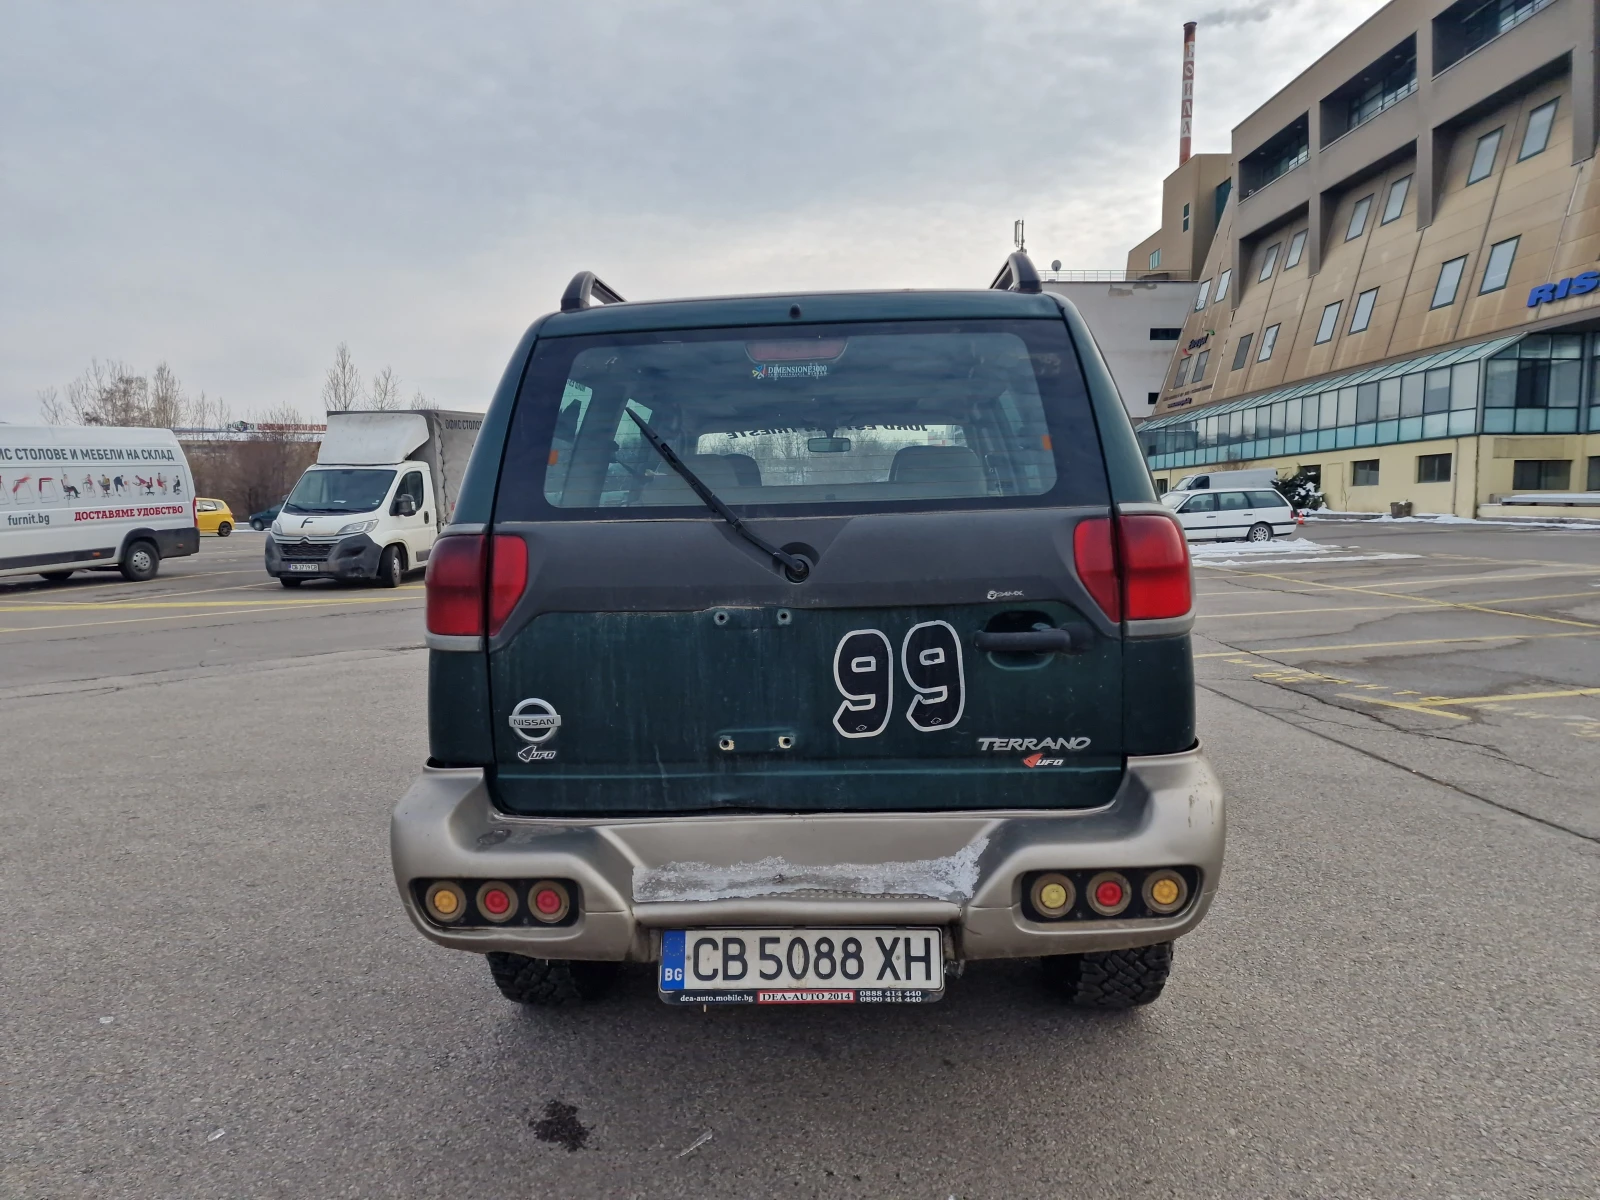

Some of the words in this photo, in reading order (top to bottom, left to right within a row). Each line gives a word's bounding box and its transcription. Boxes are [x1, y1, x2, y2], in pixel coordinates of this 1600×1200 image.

[15, 448, 68, 460] СТОЛОВЕ
[71, 449, 78, 460] И
[81, 449, 124, 460] МЕБЕЛИ
[127, 450, 140, 460] НА
[143, 450, 174, 461] СКЛАД
[8, 513, 50, 526] furnit.bg
[74, 508, 135, 521] ДОСТАВЯМЕ
[137, 505, 184, 517] УДОБСТВО
[513, 718, 555, 726] NISSAN
[978, 737, 1091, 750] TERRANO
[530, 751, 556, 760] UFO
[692, 937, 748, 981] CB
[759, 936, 864, 980] 5088
[875, 936, 932, 981] XH
[664, 967, 683, 981] BG
[680, 994, 753, 1003] dea-auto.mobile.bg
[762, 992, 825, 1001] DEA-AUTO
[828, 991, 851, 1000] 2014
